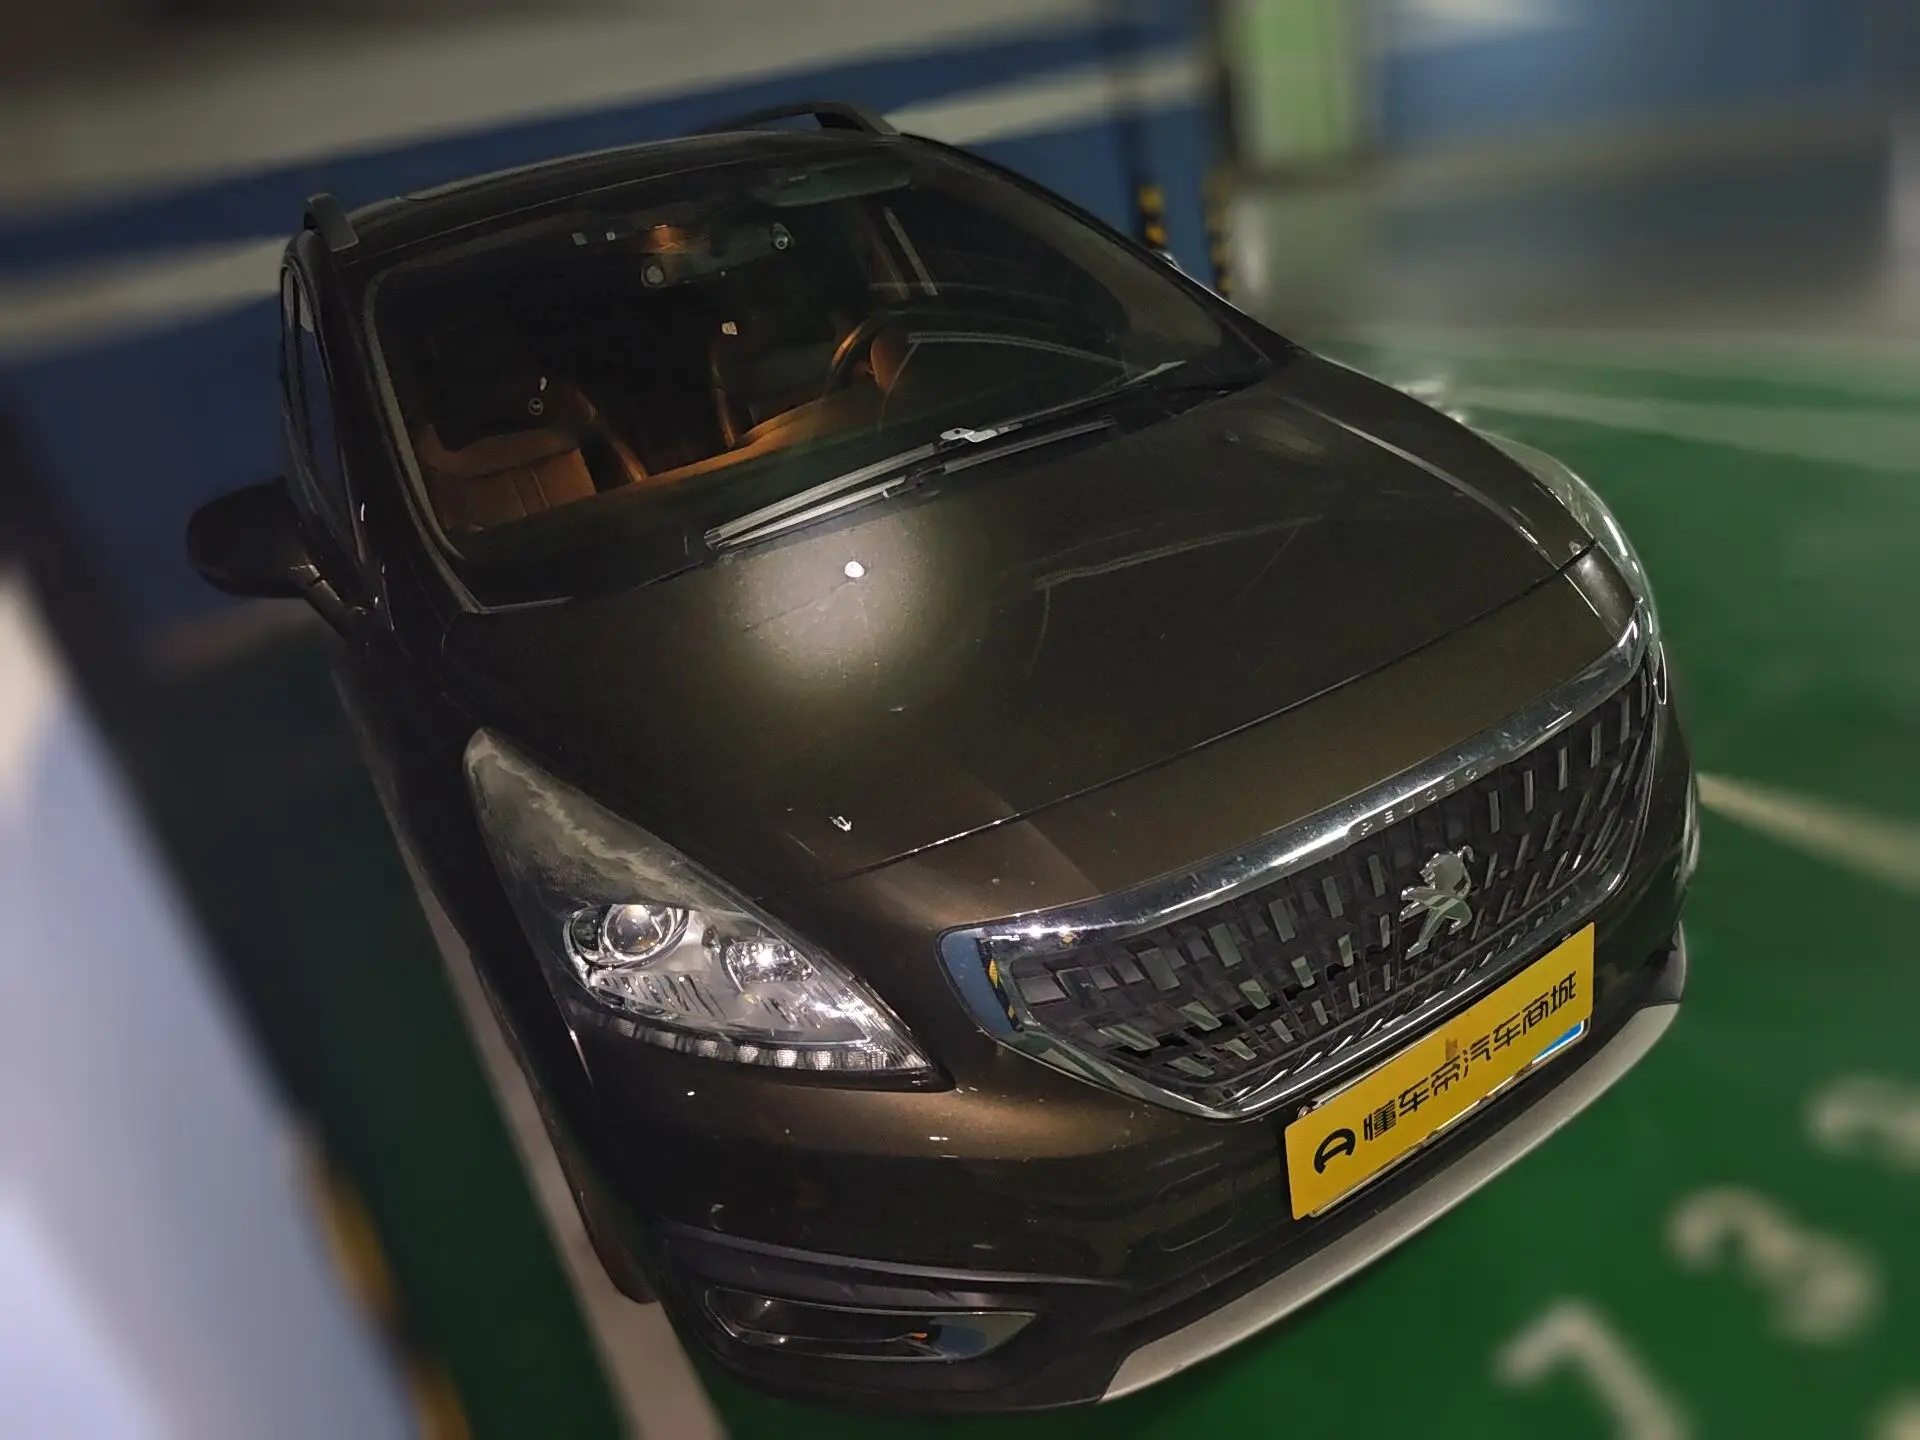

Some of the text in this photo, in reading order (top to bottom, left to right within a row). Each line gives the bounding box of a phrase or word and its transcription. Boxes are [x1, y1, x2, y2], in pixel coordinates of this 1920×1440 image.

[1363, 970, 1577, 1142] 懂车帝汽车商城
